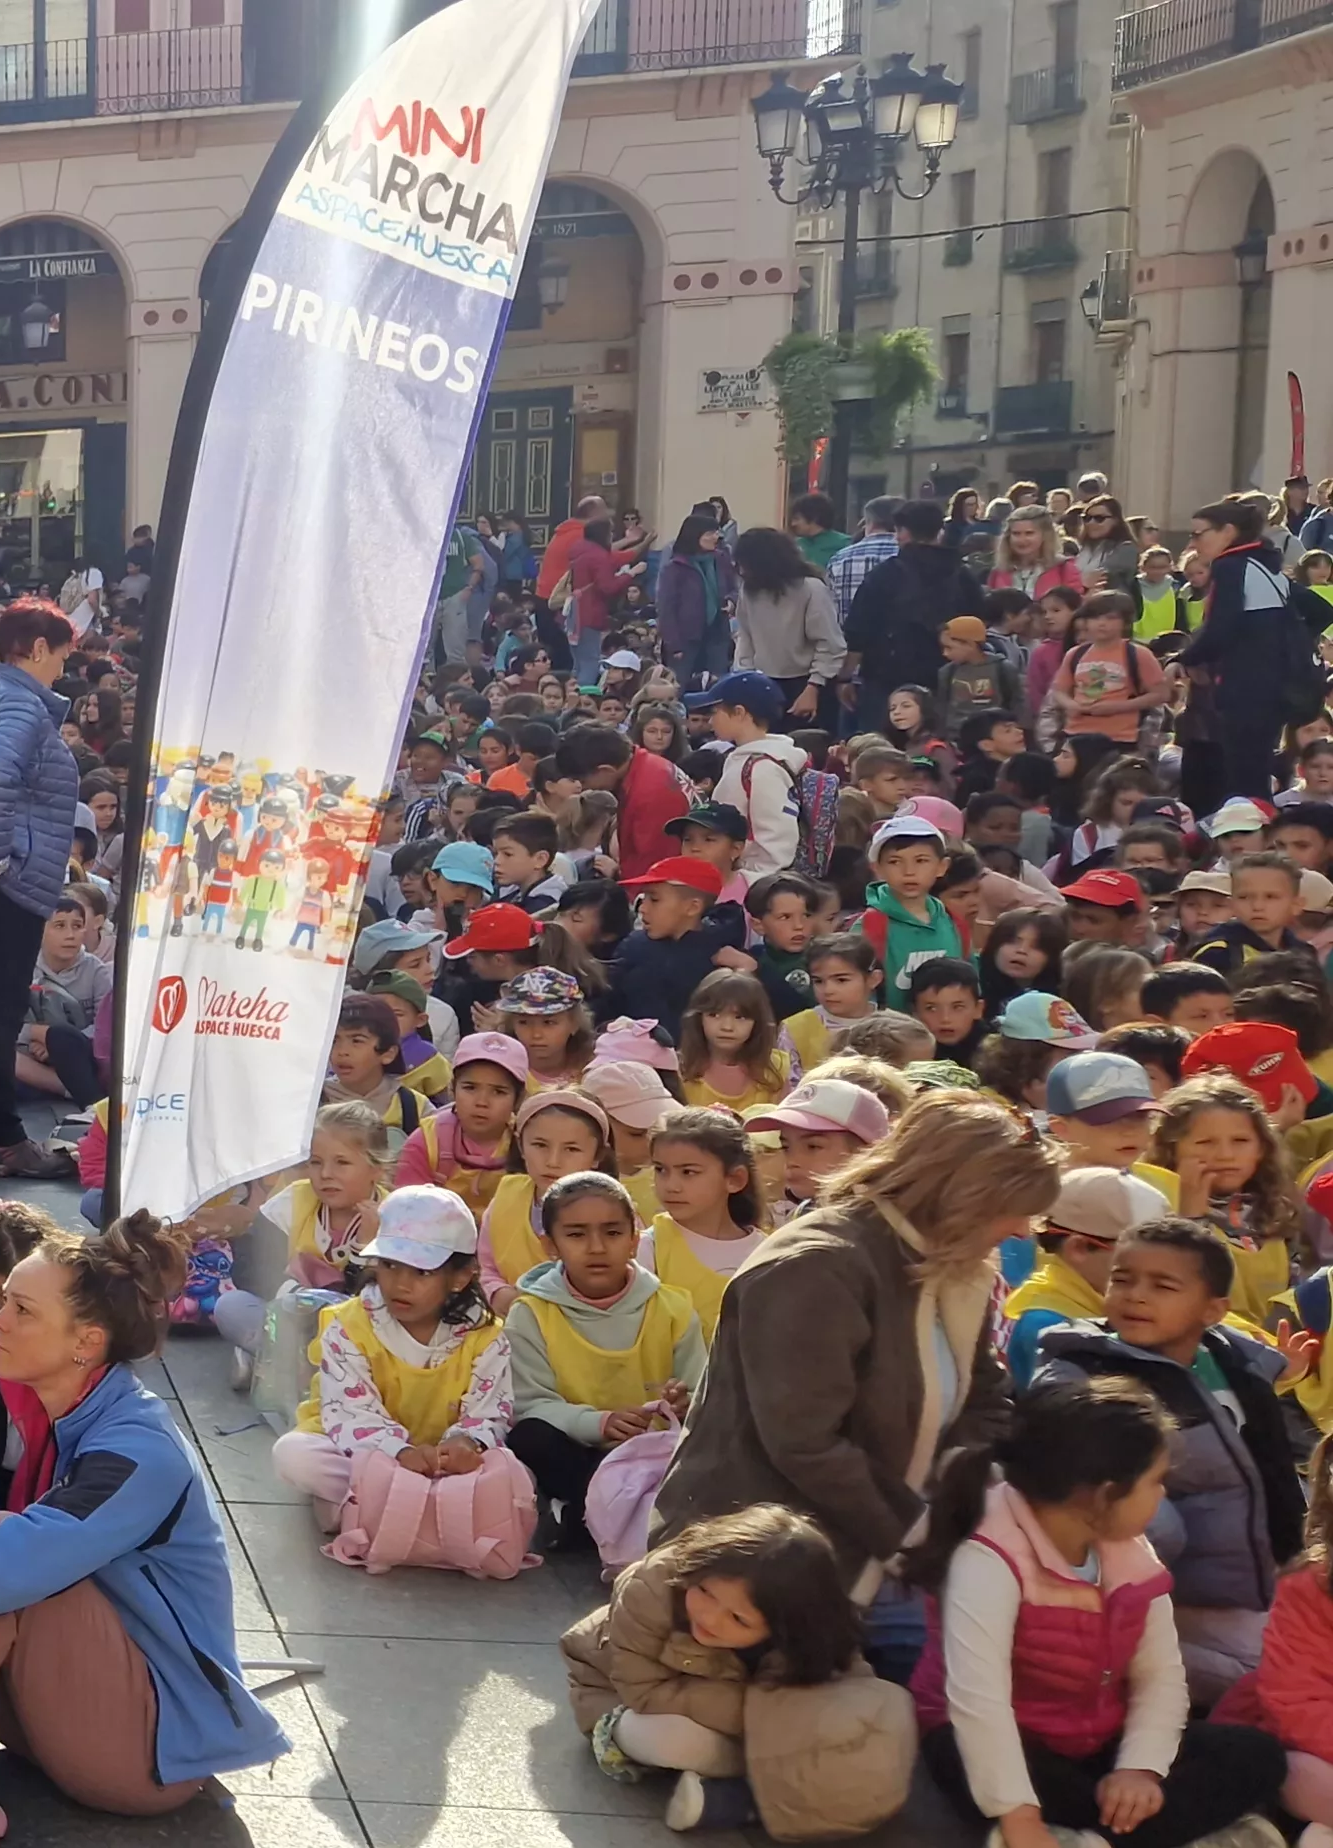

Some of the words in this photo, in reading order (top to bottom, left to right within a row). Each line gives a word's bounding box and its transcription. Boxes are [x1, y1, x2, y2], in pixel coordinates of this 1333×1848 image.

[351, 97, 487, 164] MINI
[304, 124, 518, 256] MARCHA
[553, 222, 577, 236] 1871
[29, 259, 41, 278] LA
[44, 258, 97, 277] CONFIANZA
[240, 272, 480, 394] PIRINEOS
[196, 975, 290, 1024] Marcha
[194, 1020, 230, 1037] ASPACE
[232, 1022, 282, 1041] HUESCA
